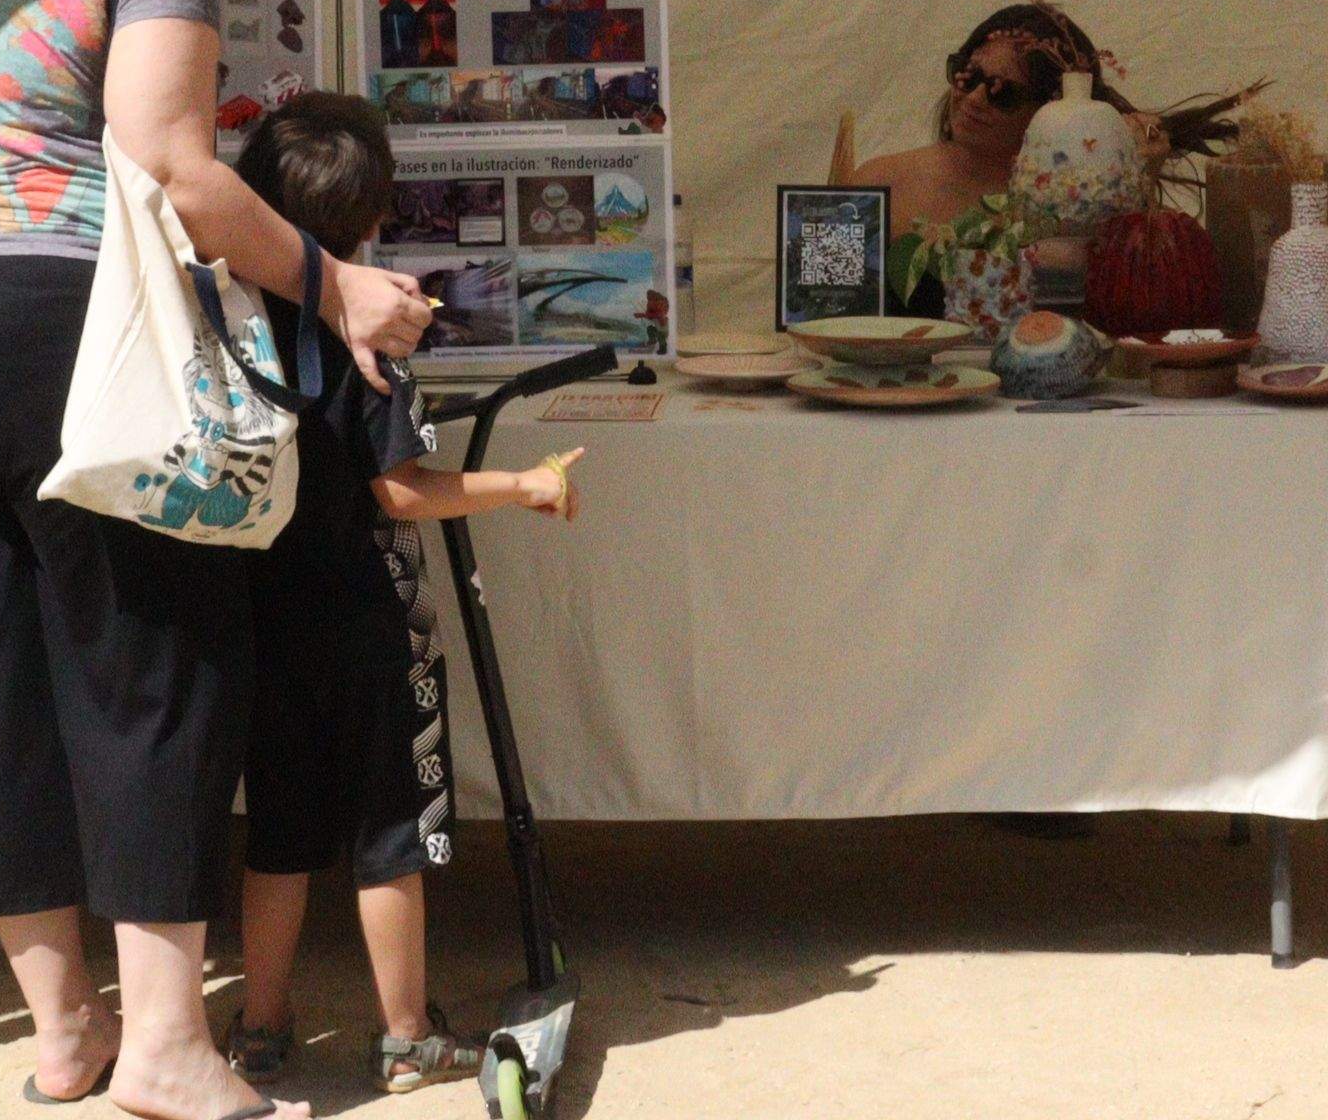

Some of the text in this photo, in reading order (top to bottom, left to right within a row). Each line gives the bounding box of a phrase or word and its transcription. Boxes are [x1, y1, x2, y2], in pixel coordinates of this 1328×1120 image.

[393, 161, 427, 173] Fases
[431, 161, 447, 173] en
[451, 158, 463, 172] la
